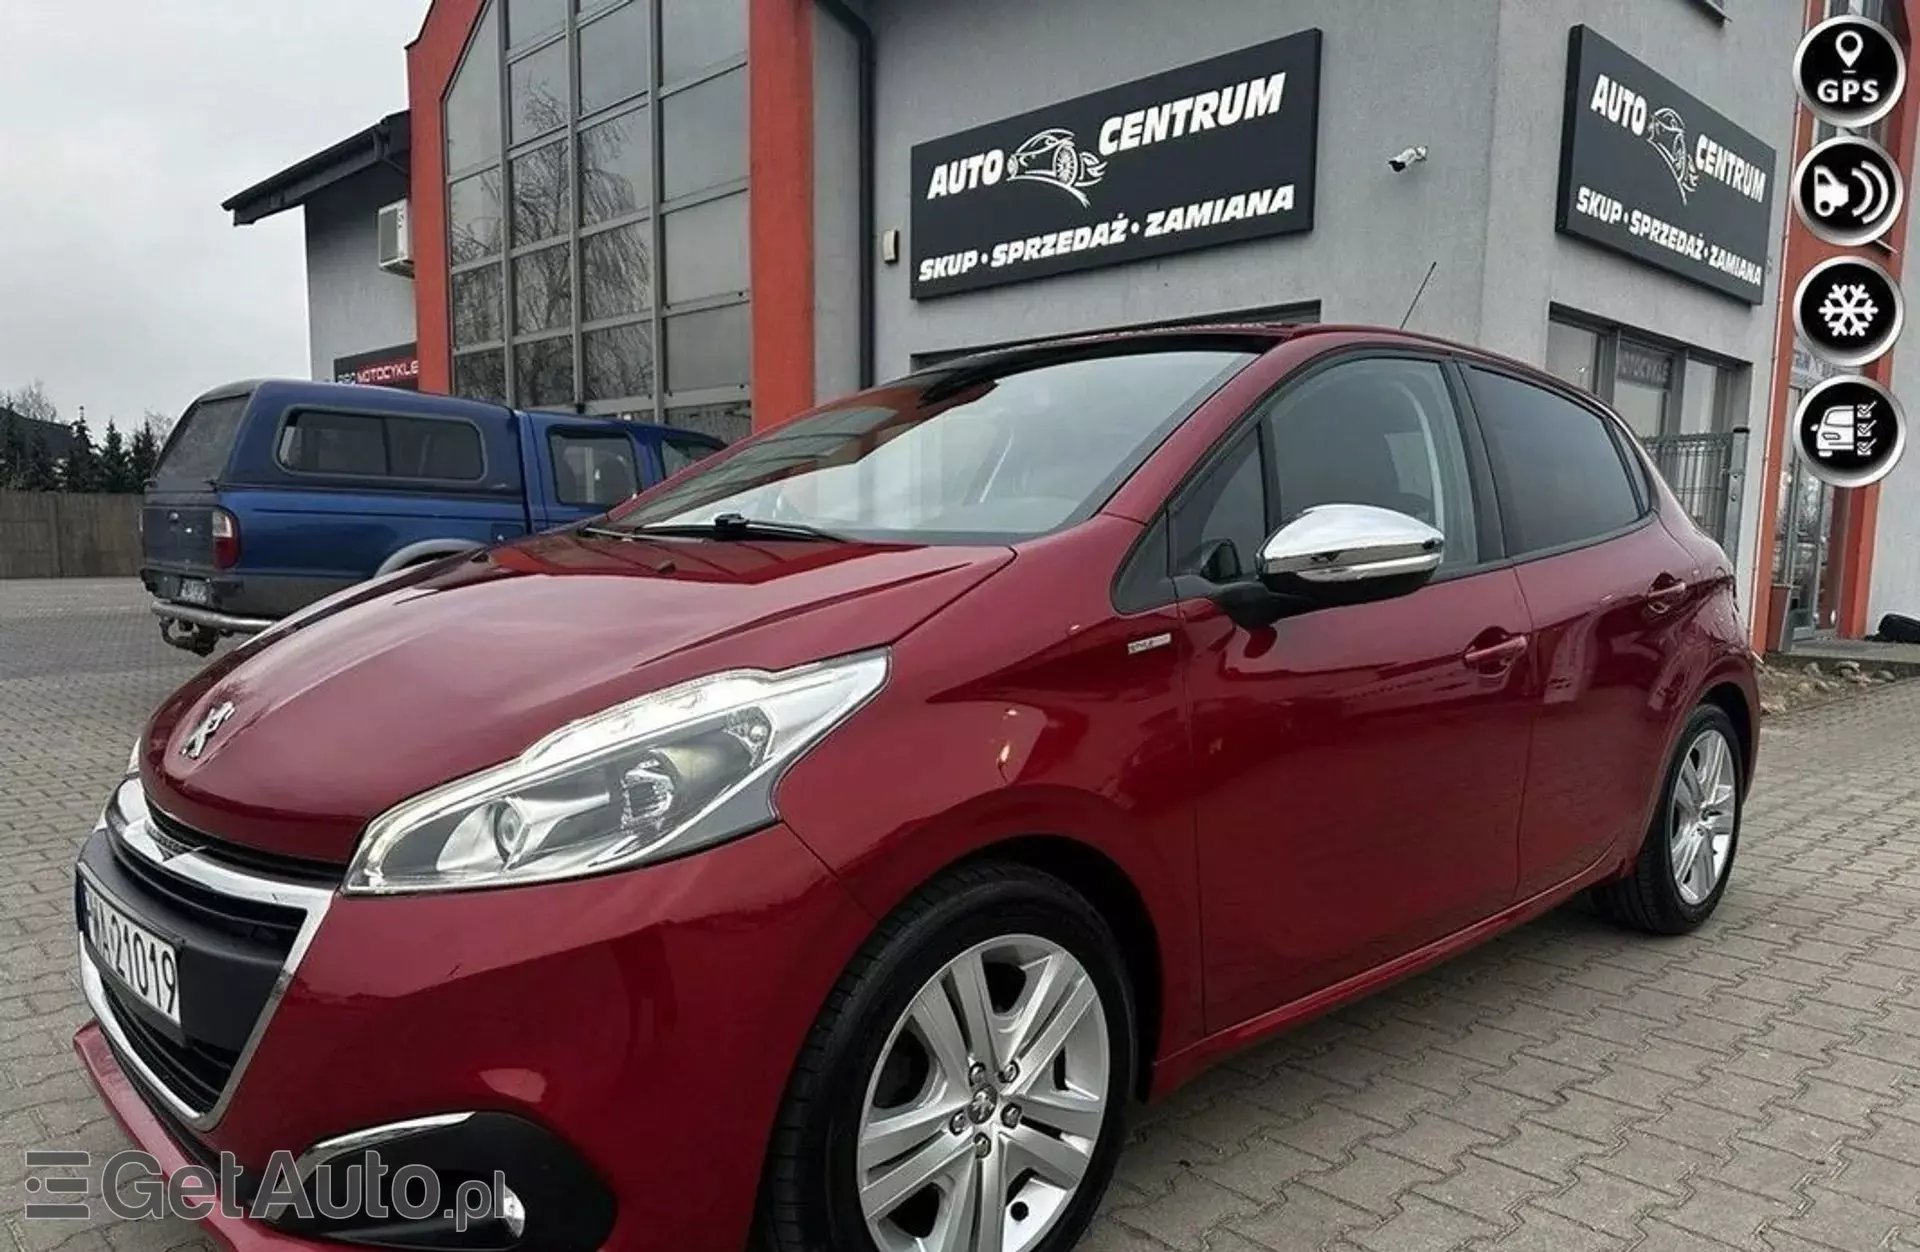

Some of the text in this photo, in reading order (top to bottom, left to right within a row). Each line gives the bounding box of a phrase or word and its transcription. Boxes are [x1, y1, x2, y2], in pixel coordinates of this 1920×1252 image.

[927, 72, 1286, 200] AUTO CENTRUM
[1590, 74, 1767, 204] AUTO CENTRUM
[918, 184, 1295, 281] SKUP SPRZEDAŻ ZAMIANA
[1575, 186, 1763, 287] SKUP SPRZEDAŻ ZAMIANA
